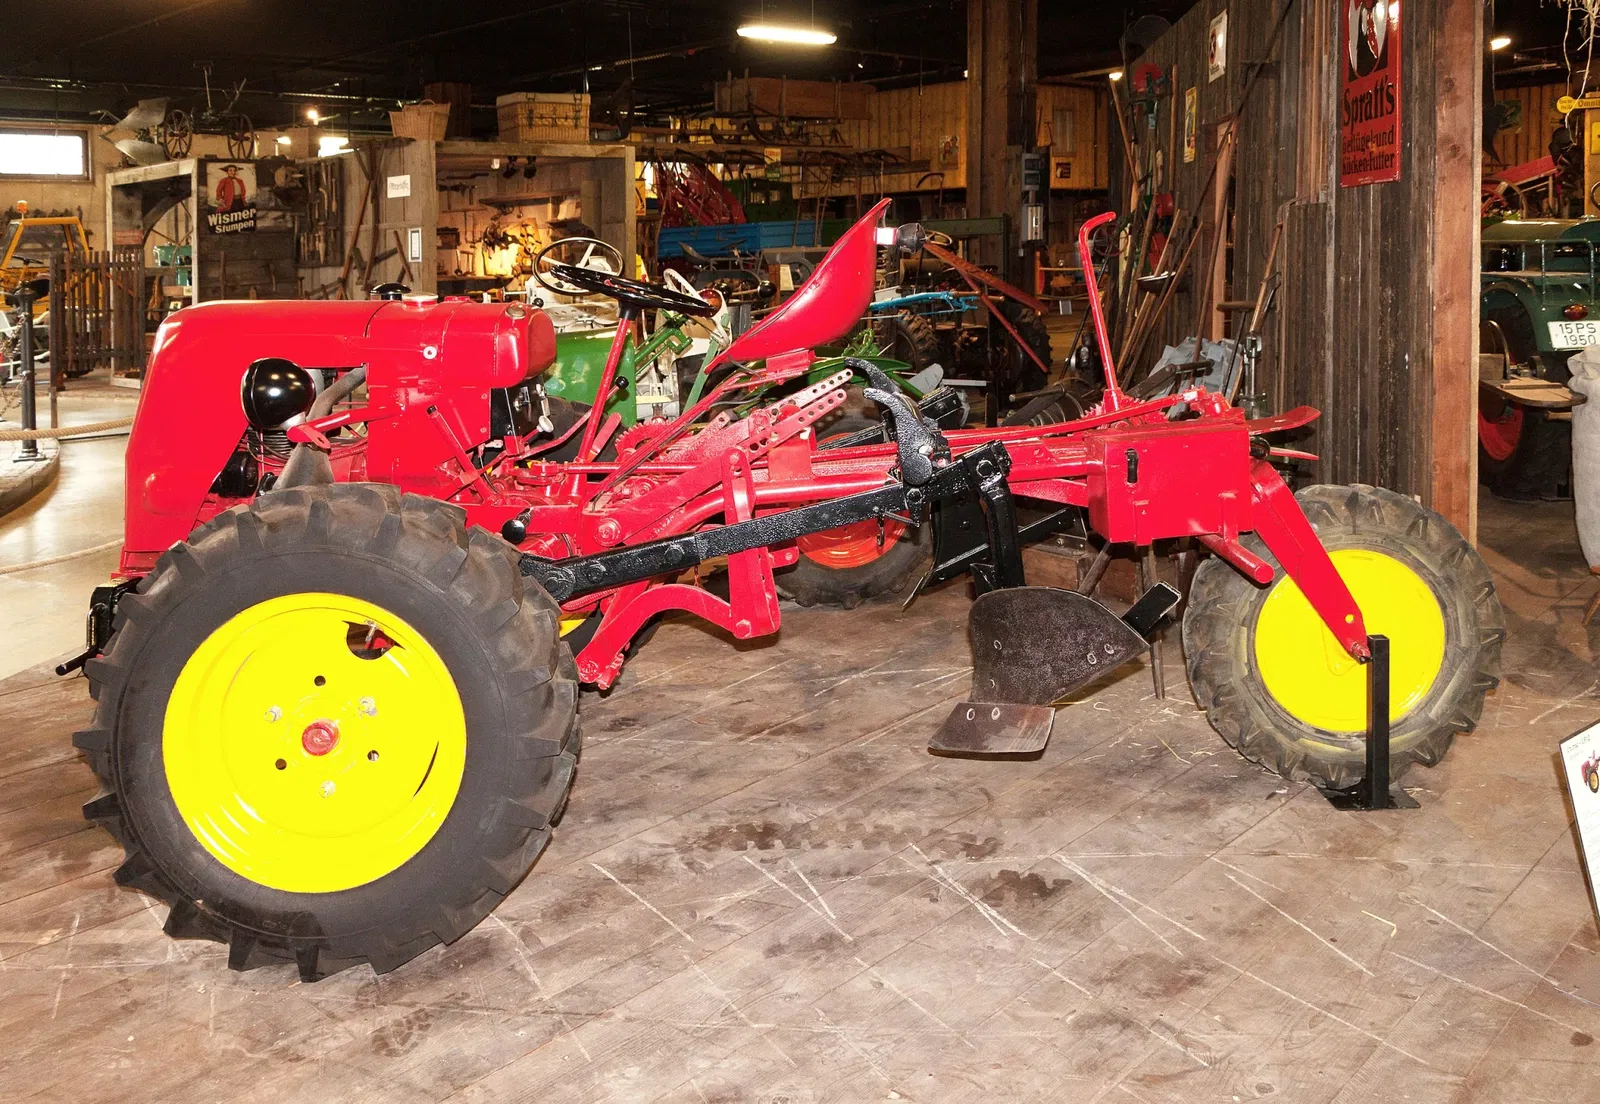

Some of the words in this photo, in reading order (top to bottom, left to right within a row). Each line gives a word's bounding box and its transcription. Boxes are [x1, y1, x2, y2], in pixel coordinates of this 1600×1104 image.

[1343, 74, 1395, 135] Spratt's
[208, 208, 257, 227] Wismer
[215, 220, 254, 234] Stumpen
[1564, 335, 1597, 346] 1950
